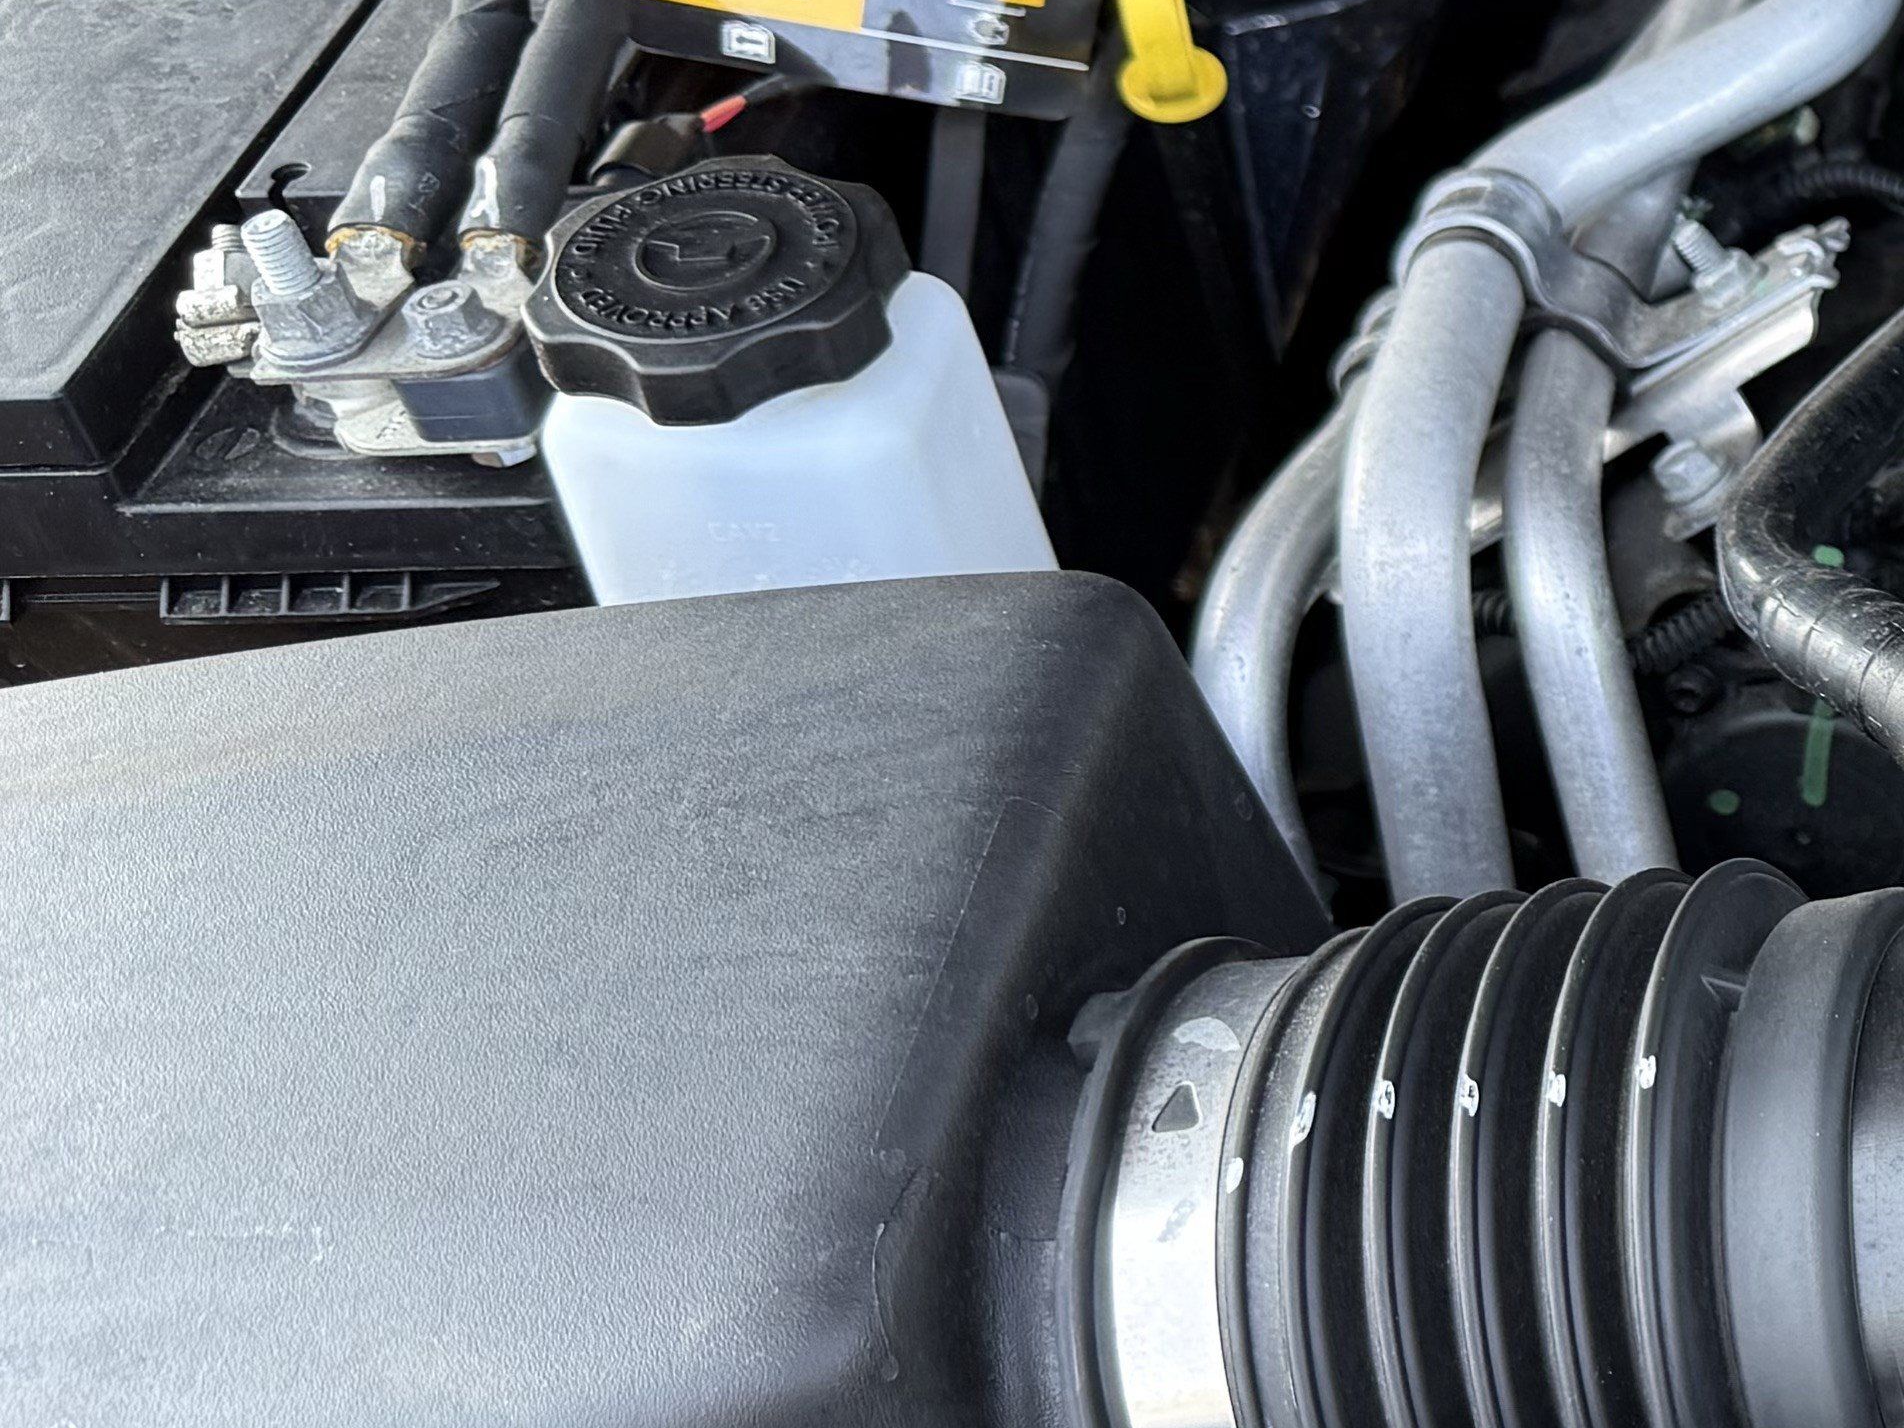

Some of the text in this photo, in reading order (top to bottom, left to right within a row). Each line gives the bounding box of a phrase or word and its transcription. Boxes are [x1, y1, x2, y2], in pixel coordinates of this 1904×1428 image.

[635, 171, 790, 205] STEERING
[571, 203, 634, 257] FLUID
[577, 276, 806, 330] USE APPROVED
